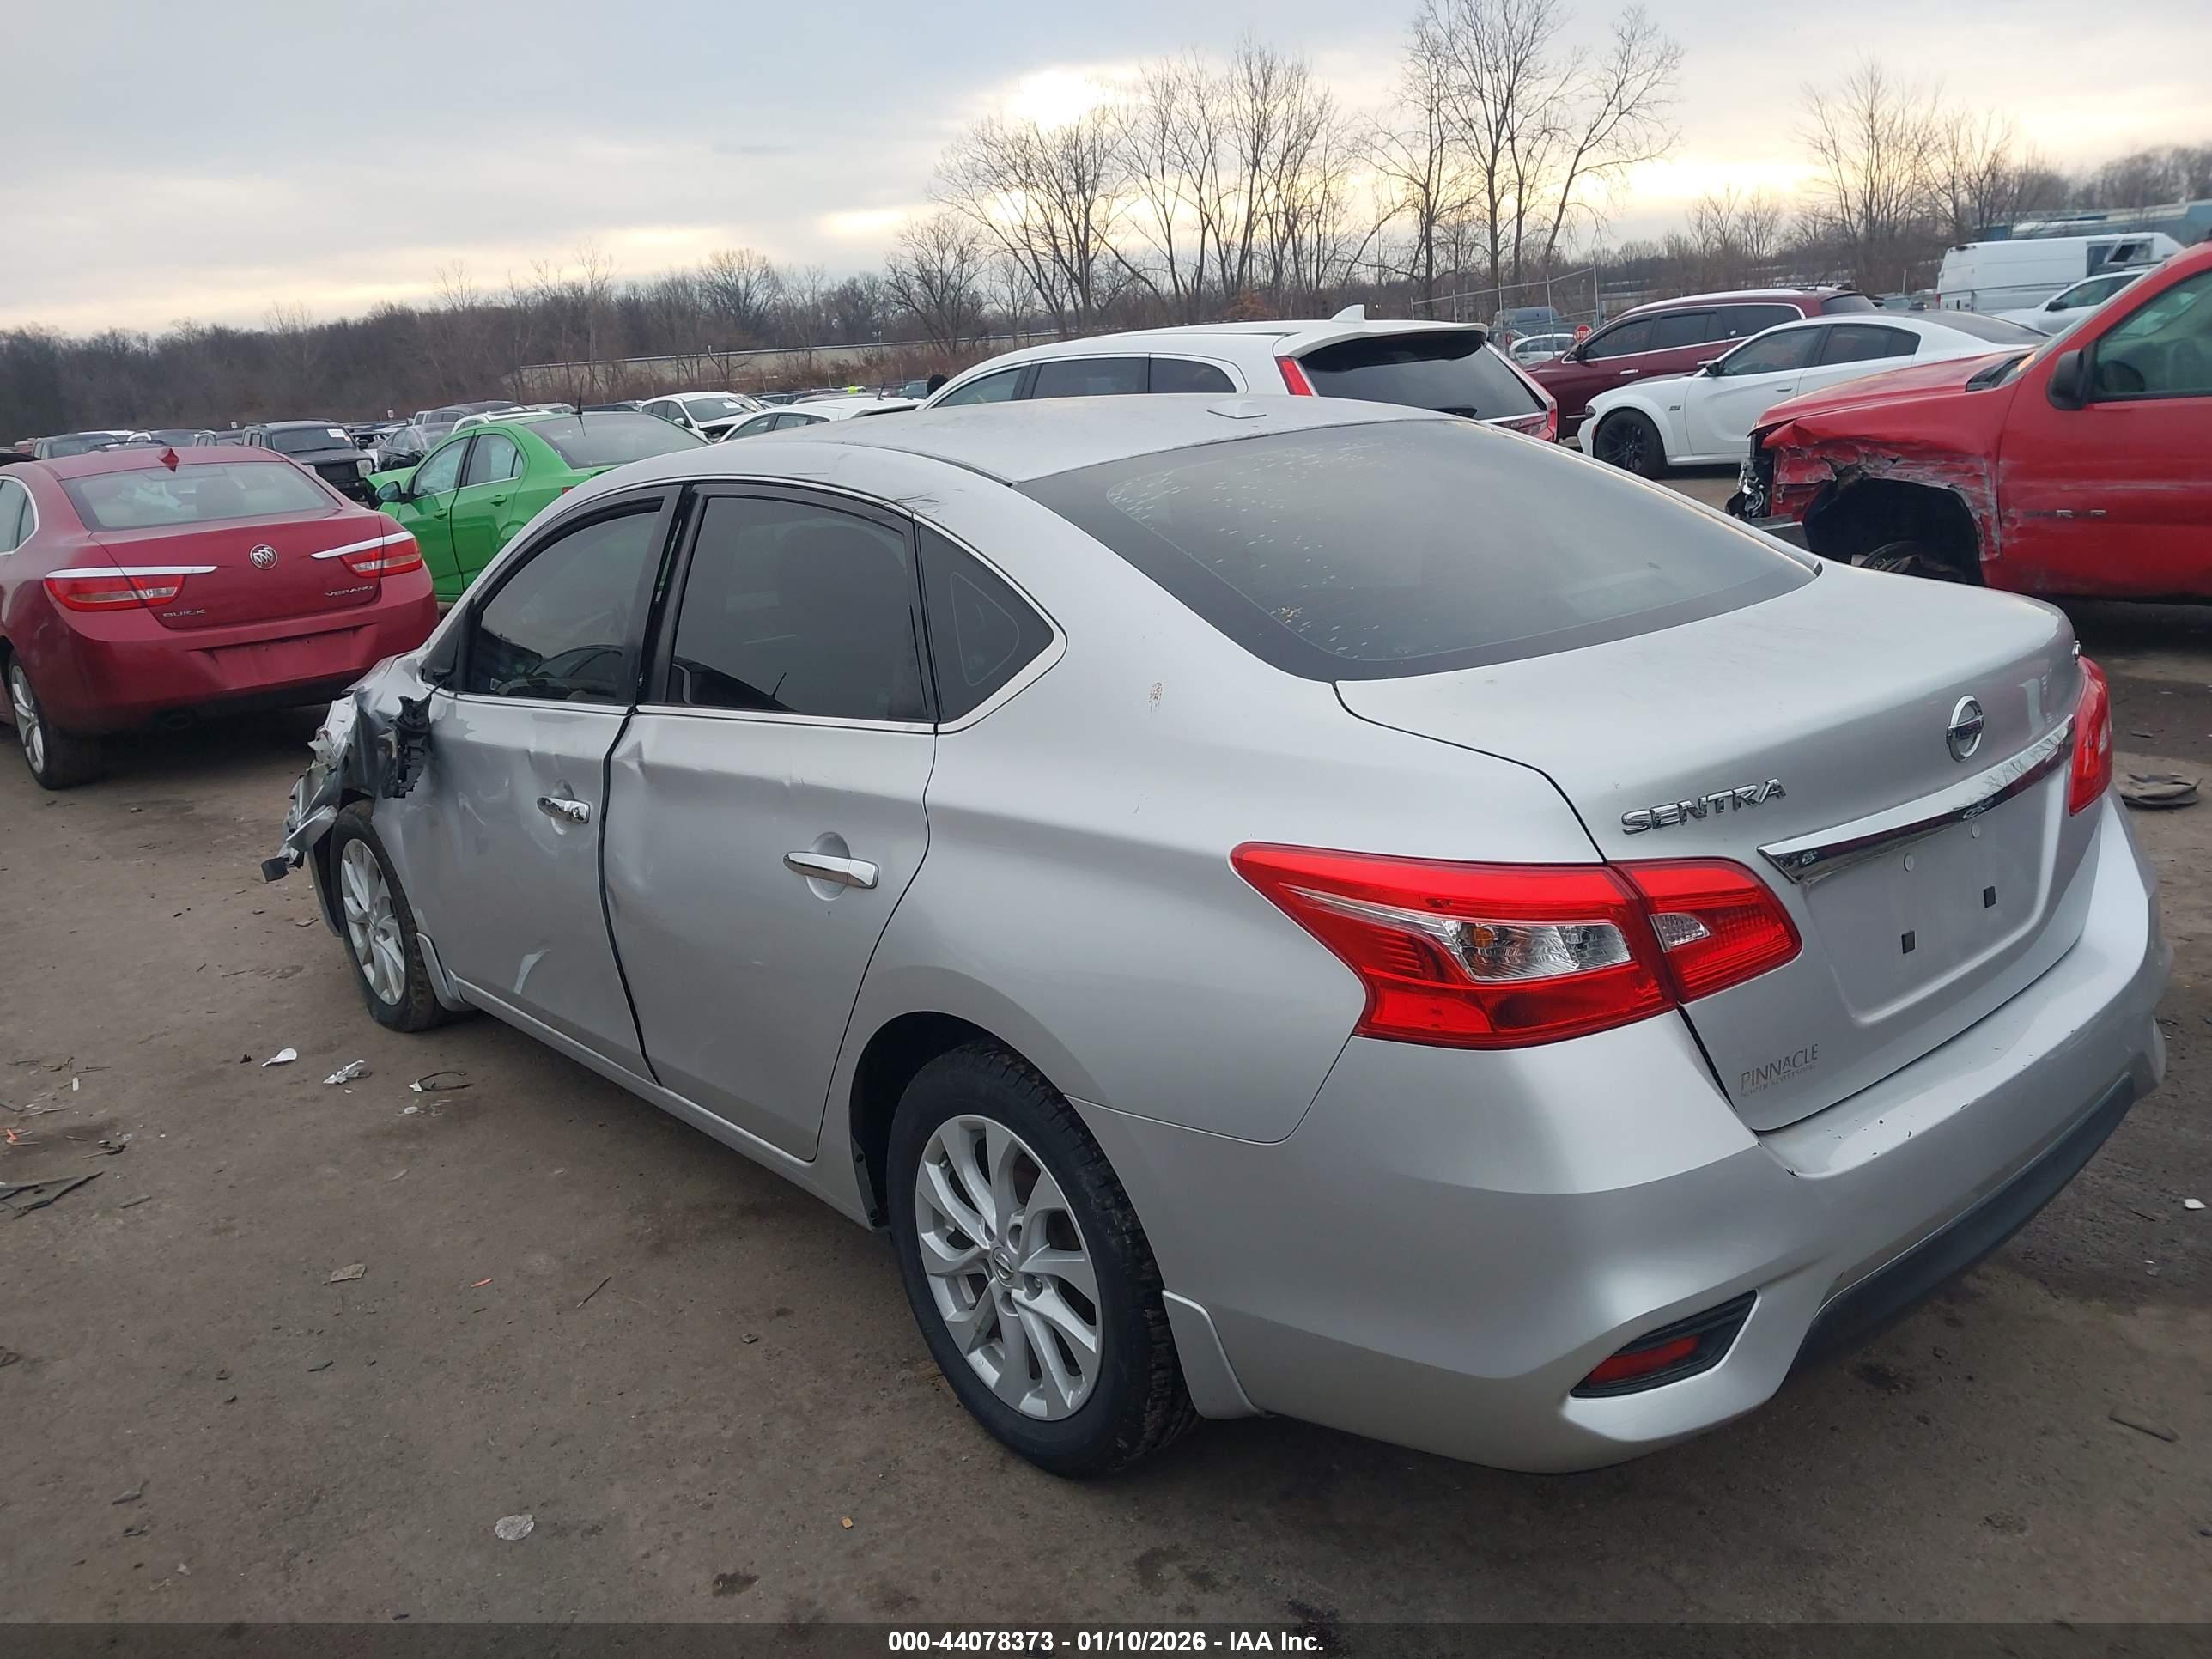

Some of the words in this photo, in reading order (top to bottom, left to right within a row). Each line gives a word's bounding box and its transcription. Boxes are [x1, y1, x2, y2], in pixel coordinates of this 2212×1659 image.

[325, 585, 373, 596] VERANO
[163, 609, 206, 617] BUICK
[1621, 778, 1787, 835] SENTRA
[1741, 1043, 1819, 1091] PINNACLE
